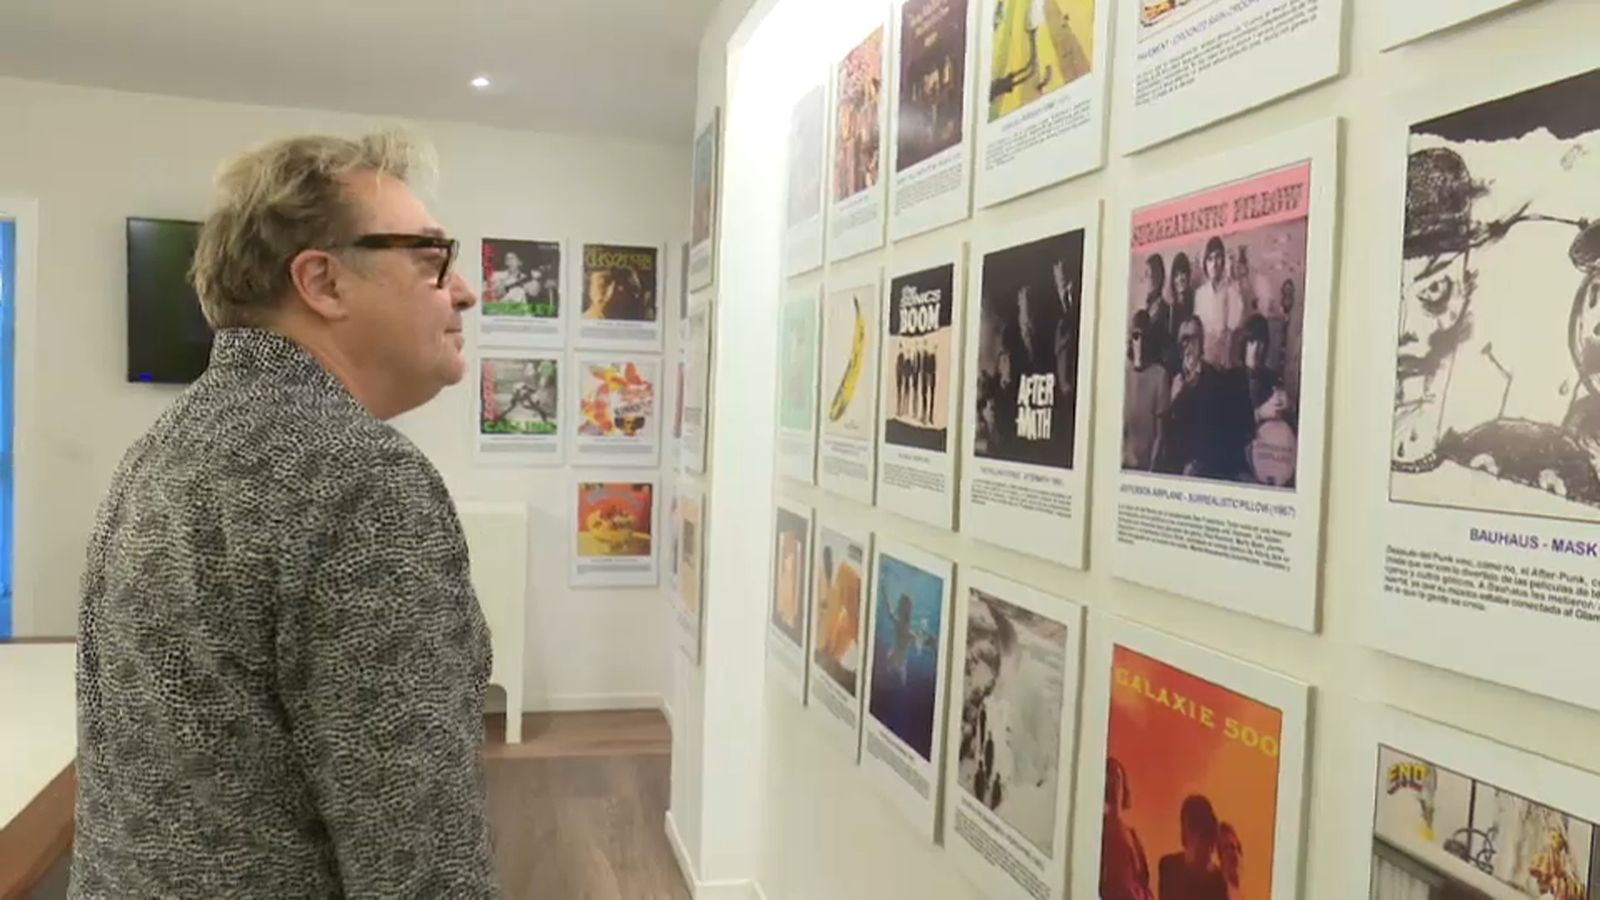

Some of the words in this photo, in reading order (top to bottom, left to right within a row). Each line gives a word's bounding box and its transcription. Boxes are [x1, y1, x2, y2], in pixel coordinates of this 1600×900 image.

[1131, 203, 1228, 247] SURREALISTIC
[1233, 183, 1303, 222] PILLOW
[899, 302, 940, 334] BOOM
[1018, 373, 1054, 406] AFTER
[1470, 528, 1539, 549] BAUHAUS
[1551, 538, 1598, 557] MASK
[1114, 667, 1216, 729] GALAXIE
[1223, 716, 1278, 759] 500
